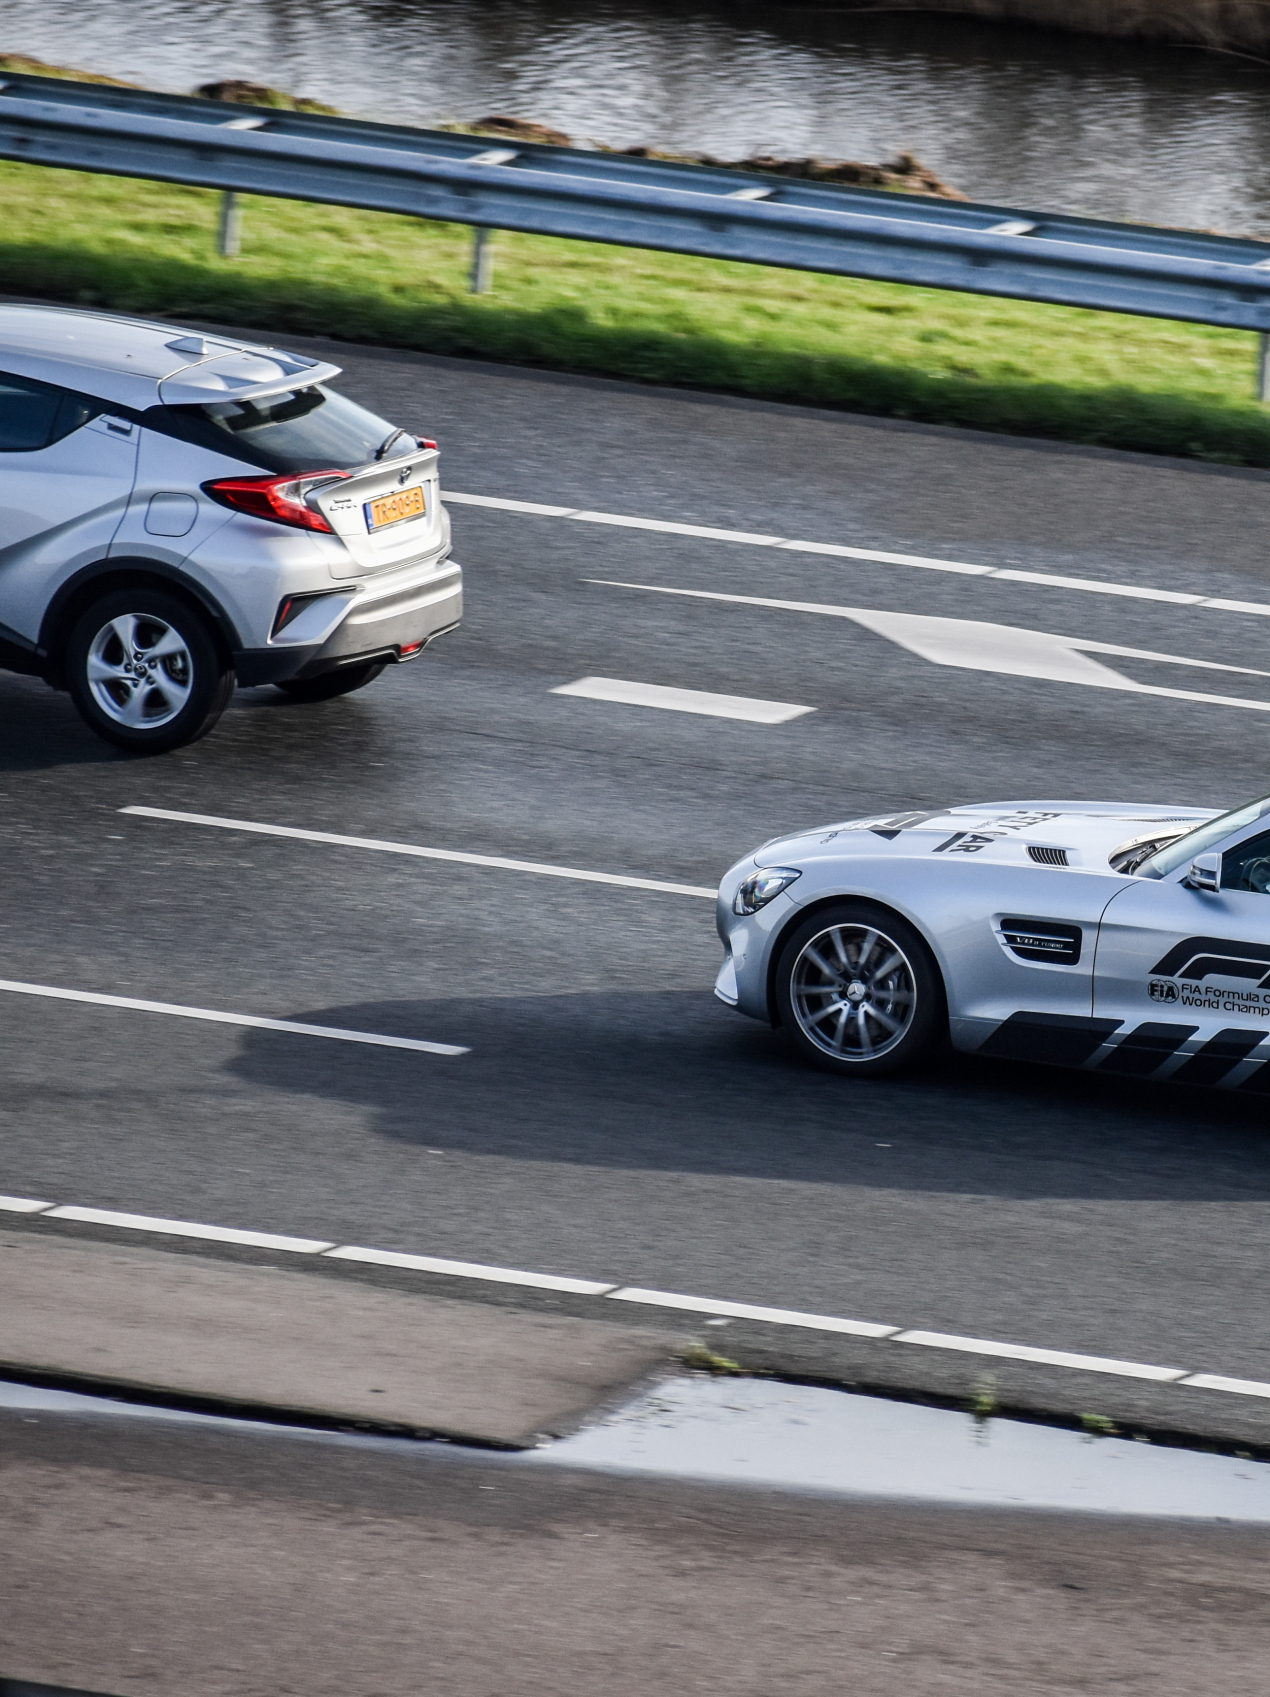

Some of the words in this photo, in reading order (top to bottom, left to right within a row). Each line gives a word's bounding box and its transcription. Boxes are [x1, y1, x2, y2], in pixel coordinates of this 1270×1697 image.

[374, 492, 420, 522] TR-909-B
[1181, 983, 1202, 996] FIA
[1204, 987, 1260, 1002] Formula
[1181, 995, 1220, 1010] World
